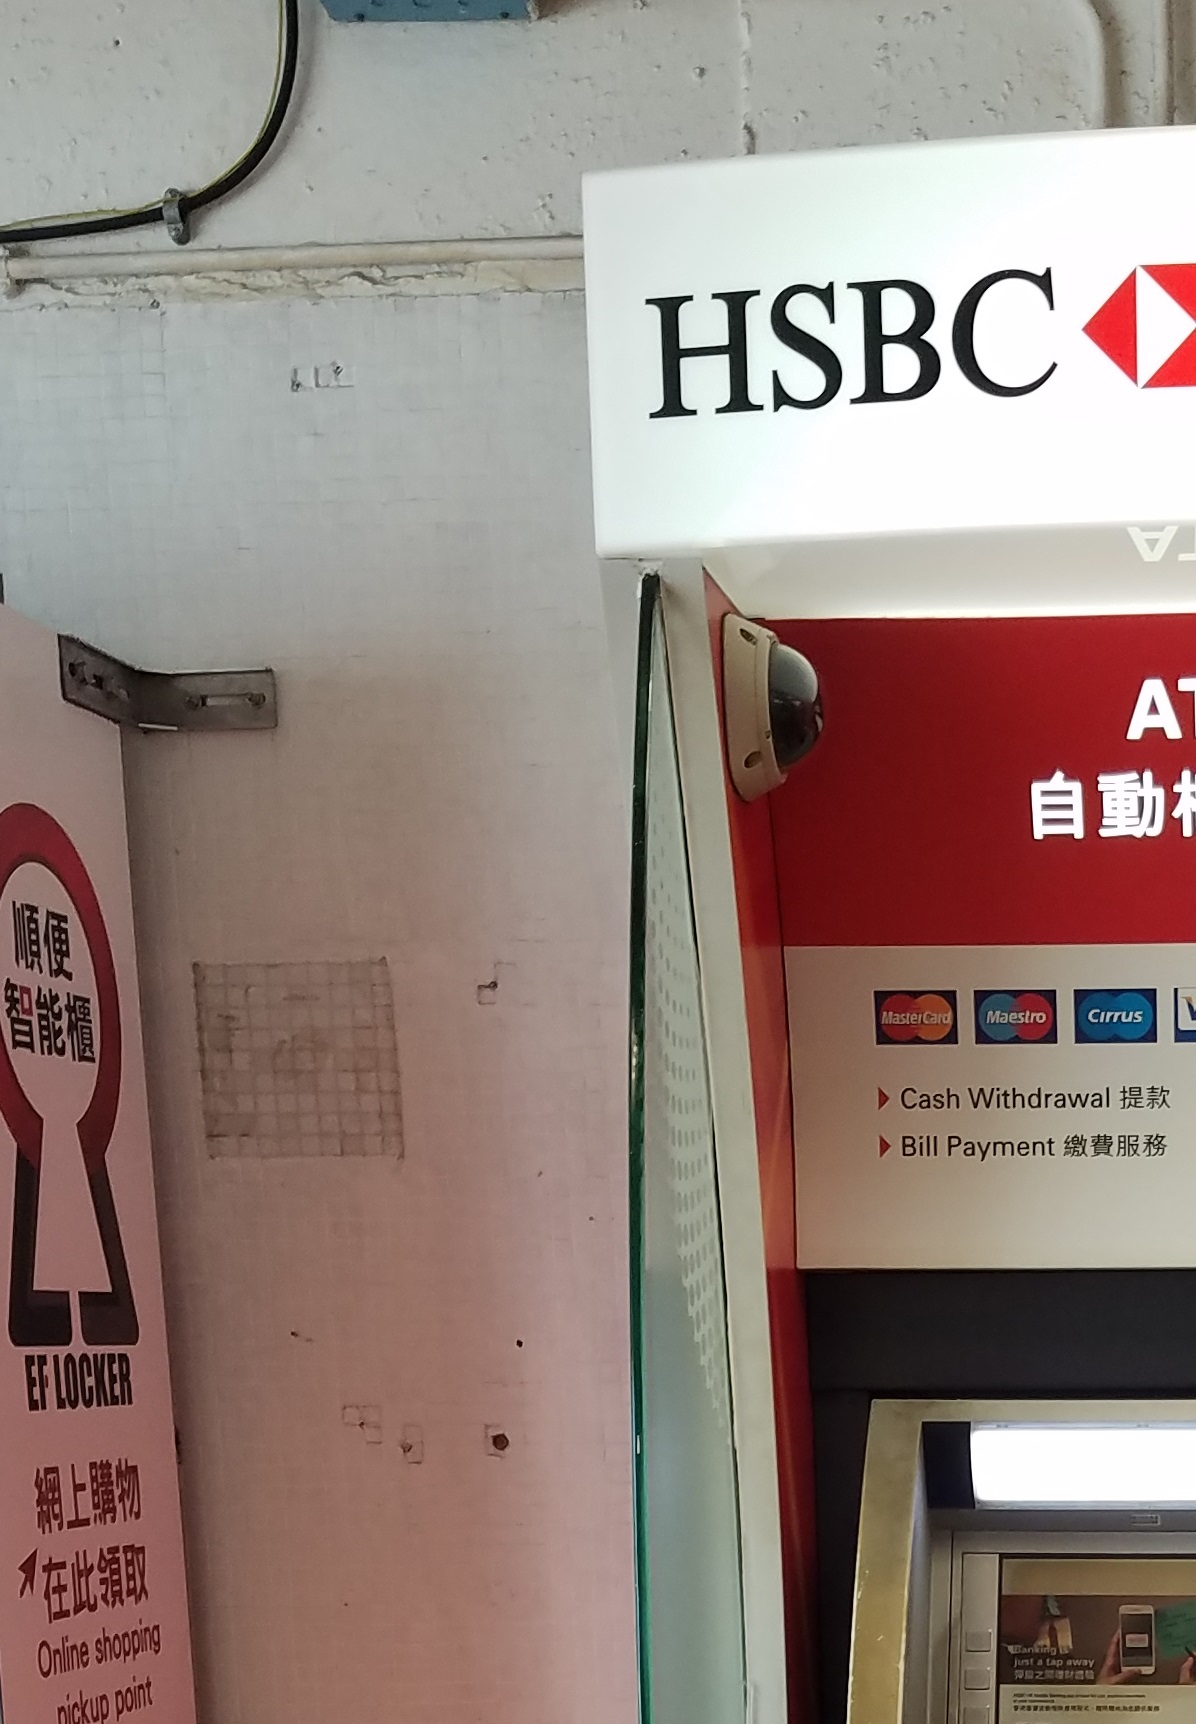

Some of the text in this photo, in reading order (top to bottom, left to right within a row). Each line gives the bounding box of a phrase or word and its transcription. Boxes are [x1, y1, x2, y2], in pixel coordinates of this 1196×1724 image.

[646, 265, 1059, 420] HSBC
[12, 900, 73, 982] 順便
[4, 978, 97, 1064] 智能櫃
[881, 1011, 951, 1025] MasterCard
[986, 1010, 1047, 1024] Maestro
[1087, 1008, 1143, 1024] Cirrus
[900, 1085, 1171, 1109] Cash Withdrawal 提款
[901, 1133, 1168, 1161] Bill Payment 繳費服務
[24, 1353, 134, 1411] EF LOCKER
[34, 1458, 141, 1535] 網上購物
[41, 1544, 149, 1624] 在此領取
[37, 1619, 162, 1679] Online shopping
[1066, 1659, 1095, 1668] away
[114, 1675, 154, 1722] point
